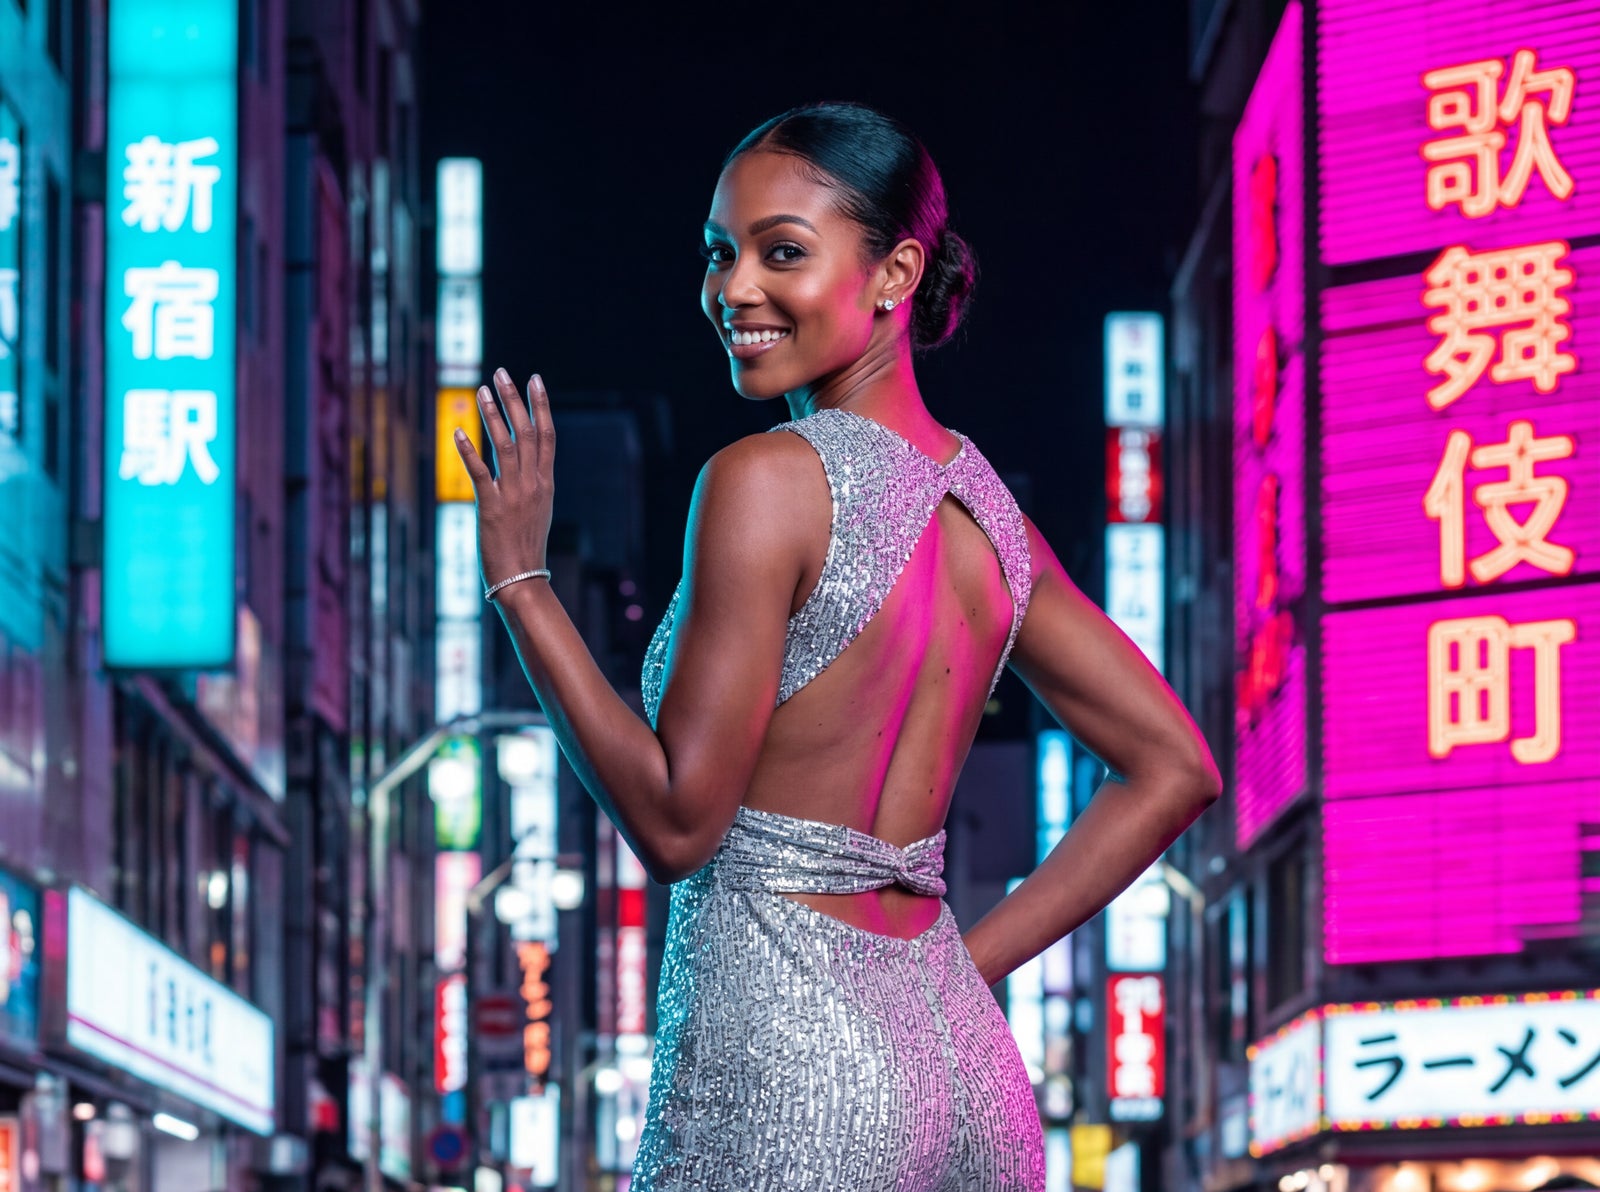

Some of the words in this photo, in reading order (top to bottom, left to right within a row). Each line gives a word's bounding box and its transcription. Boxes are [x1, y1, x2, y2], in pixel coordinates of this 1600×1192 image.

[119, 134, 220, 486] 新宿駅
[1421, 48, 1576, 764] 歌舞伎町
[1355, 1027, 1600, 1101] ラーメン
